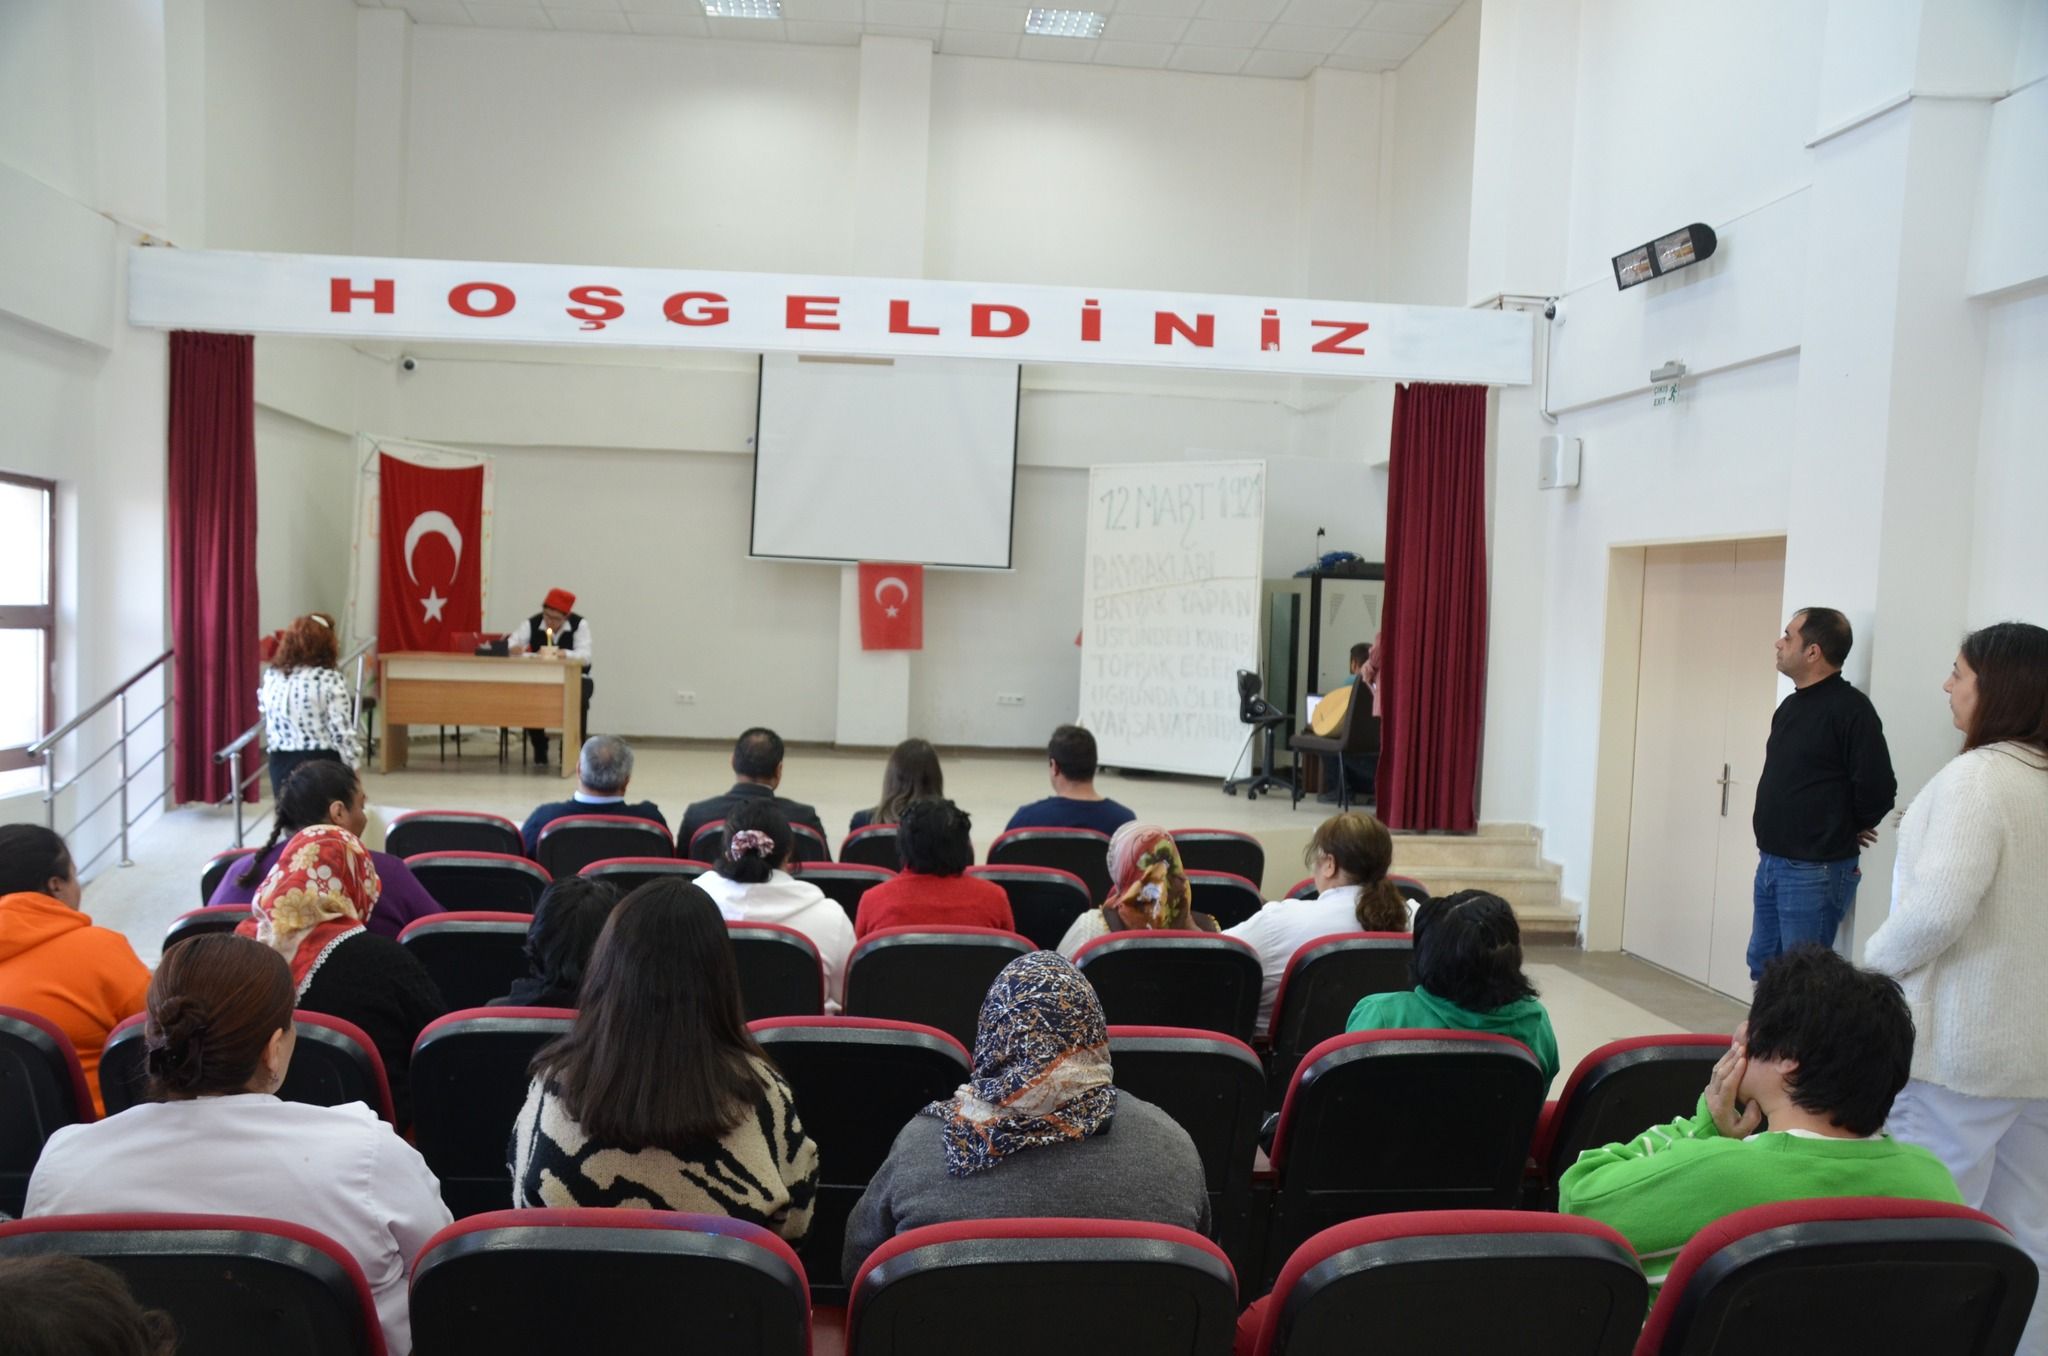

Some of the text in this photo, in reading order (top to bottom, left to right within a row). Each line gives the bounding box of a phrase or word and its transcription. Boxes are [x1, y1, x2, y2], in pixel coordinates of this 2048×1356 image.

[332, 279, 1367, 355] HOŞGELDİNİZ
[1100, 486, 1129, 530] 12
[1135, 484, 1214, 551] MART
